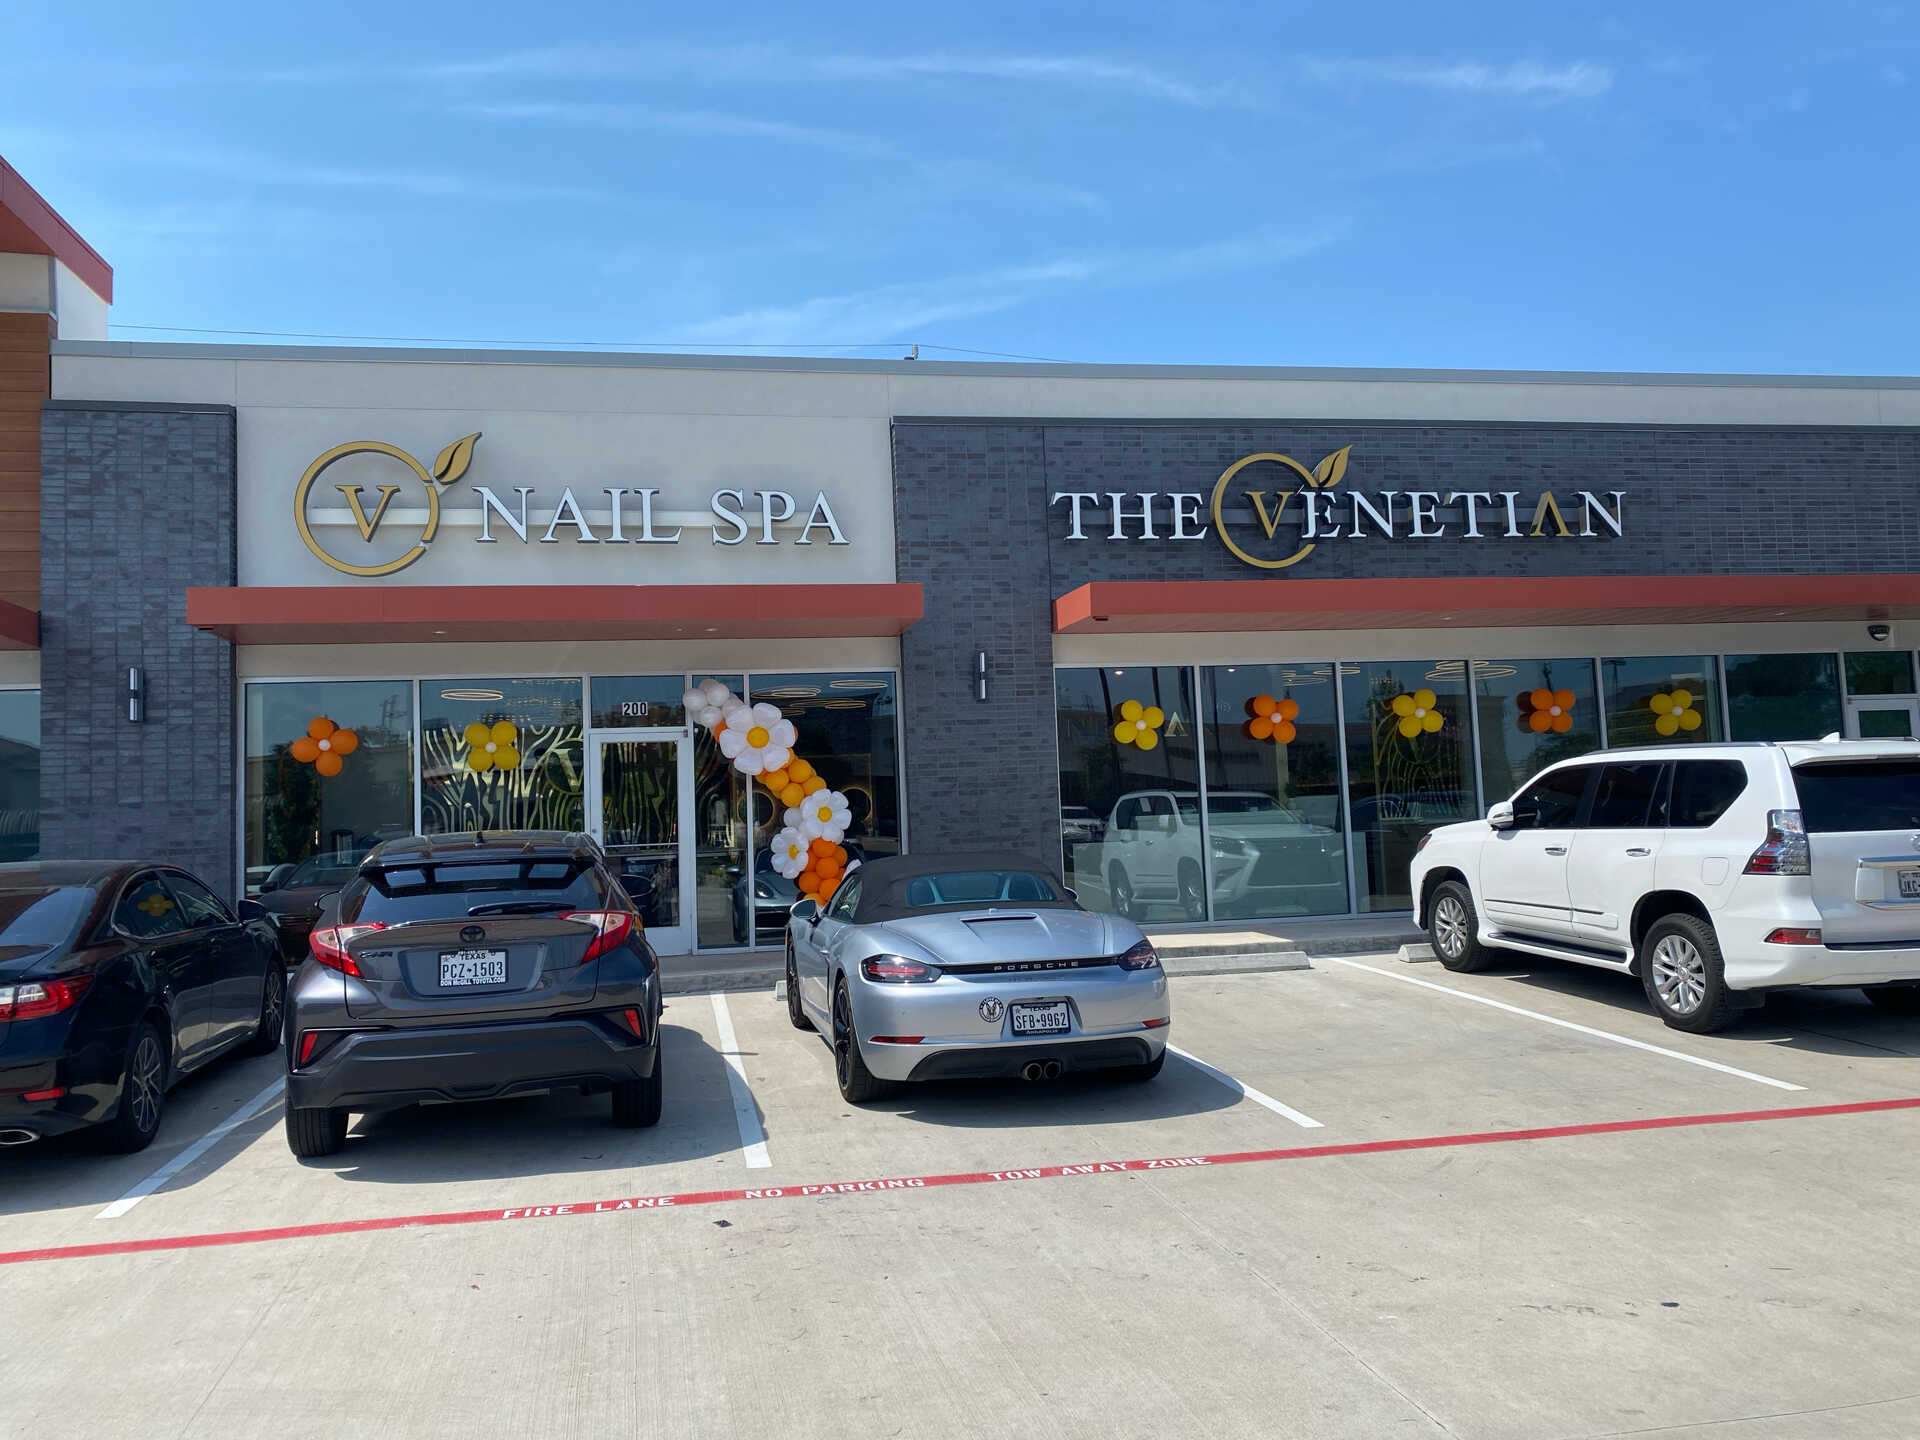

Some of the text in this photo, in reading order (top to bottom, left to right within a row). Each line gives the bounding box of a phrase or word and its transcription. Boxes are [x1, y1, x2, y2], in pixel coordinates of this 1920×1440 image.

[471, 486, 682, 544] NAIL
[711, 488, 850, 545] SPA
[1051, 491, 1208, 541] THE
[623, 702, 648, 716] 200
[993, 961, 1079, 971] PORSCHE
[502, 1156, 1213, 1220] FIRE LANE NO PARKING TOW AWAY ZONE
